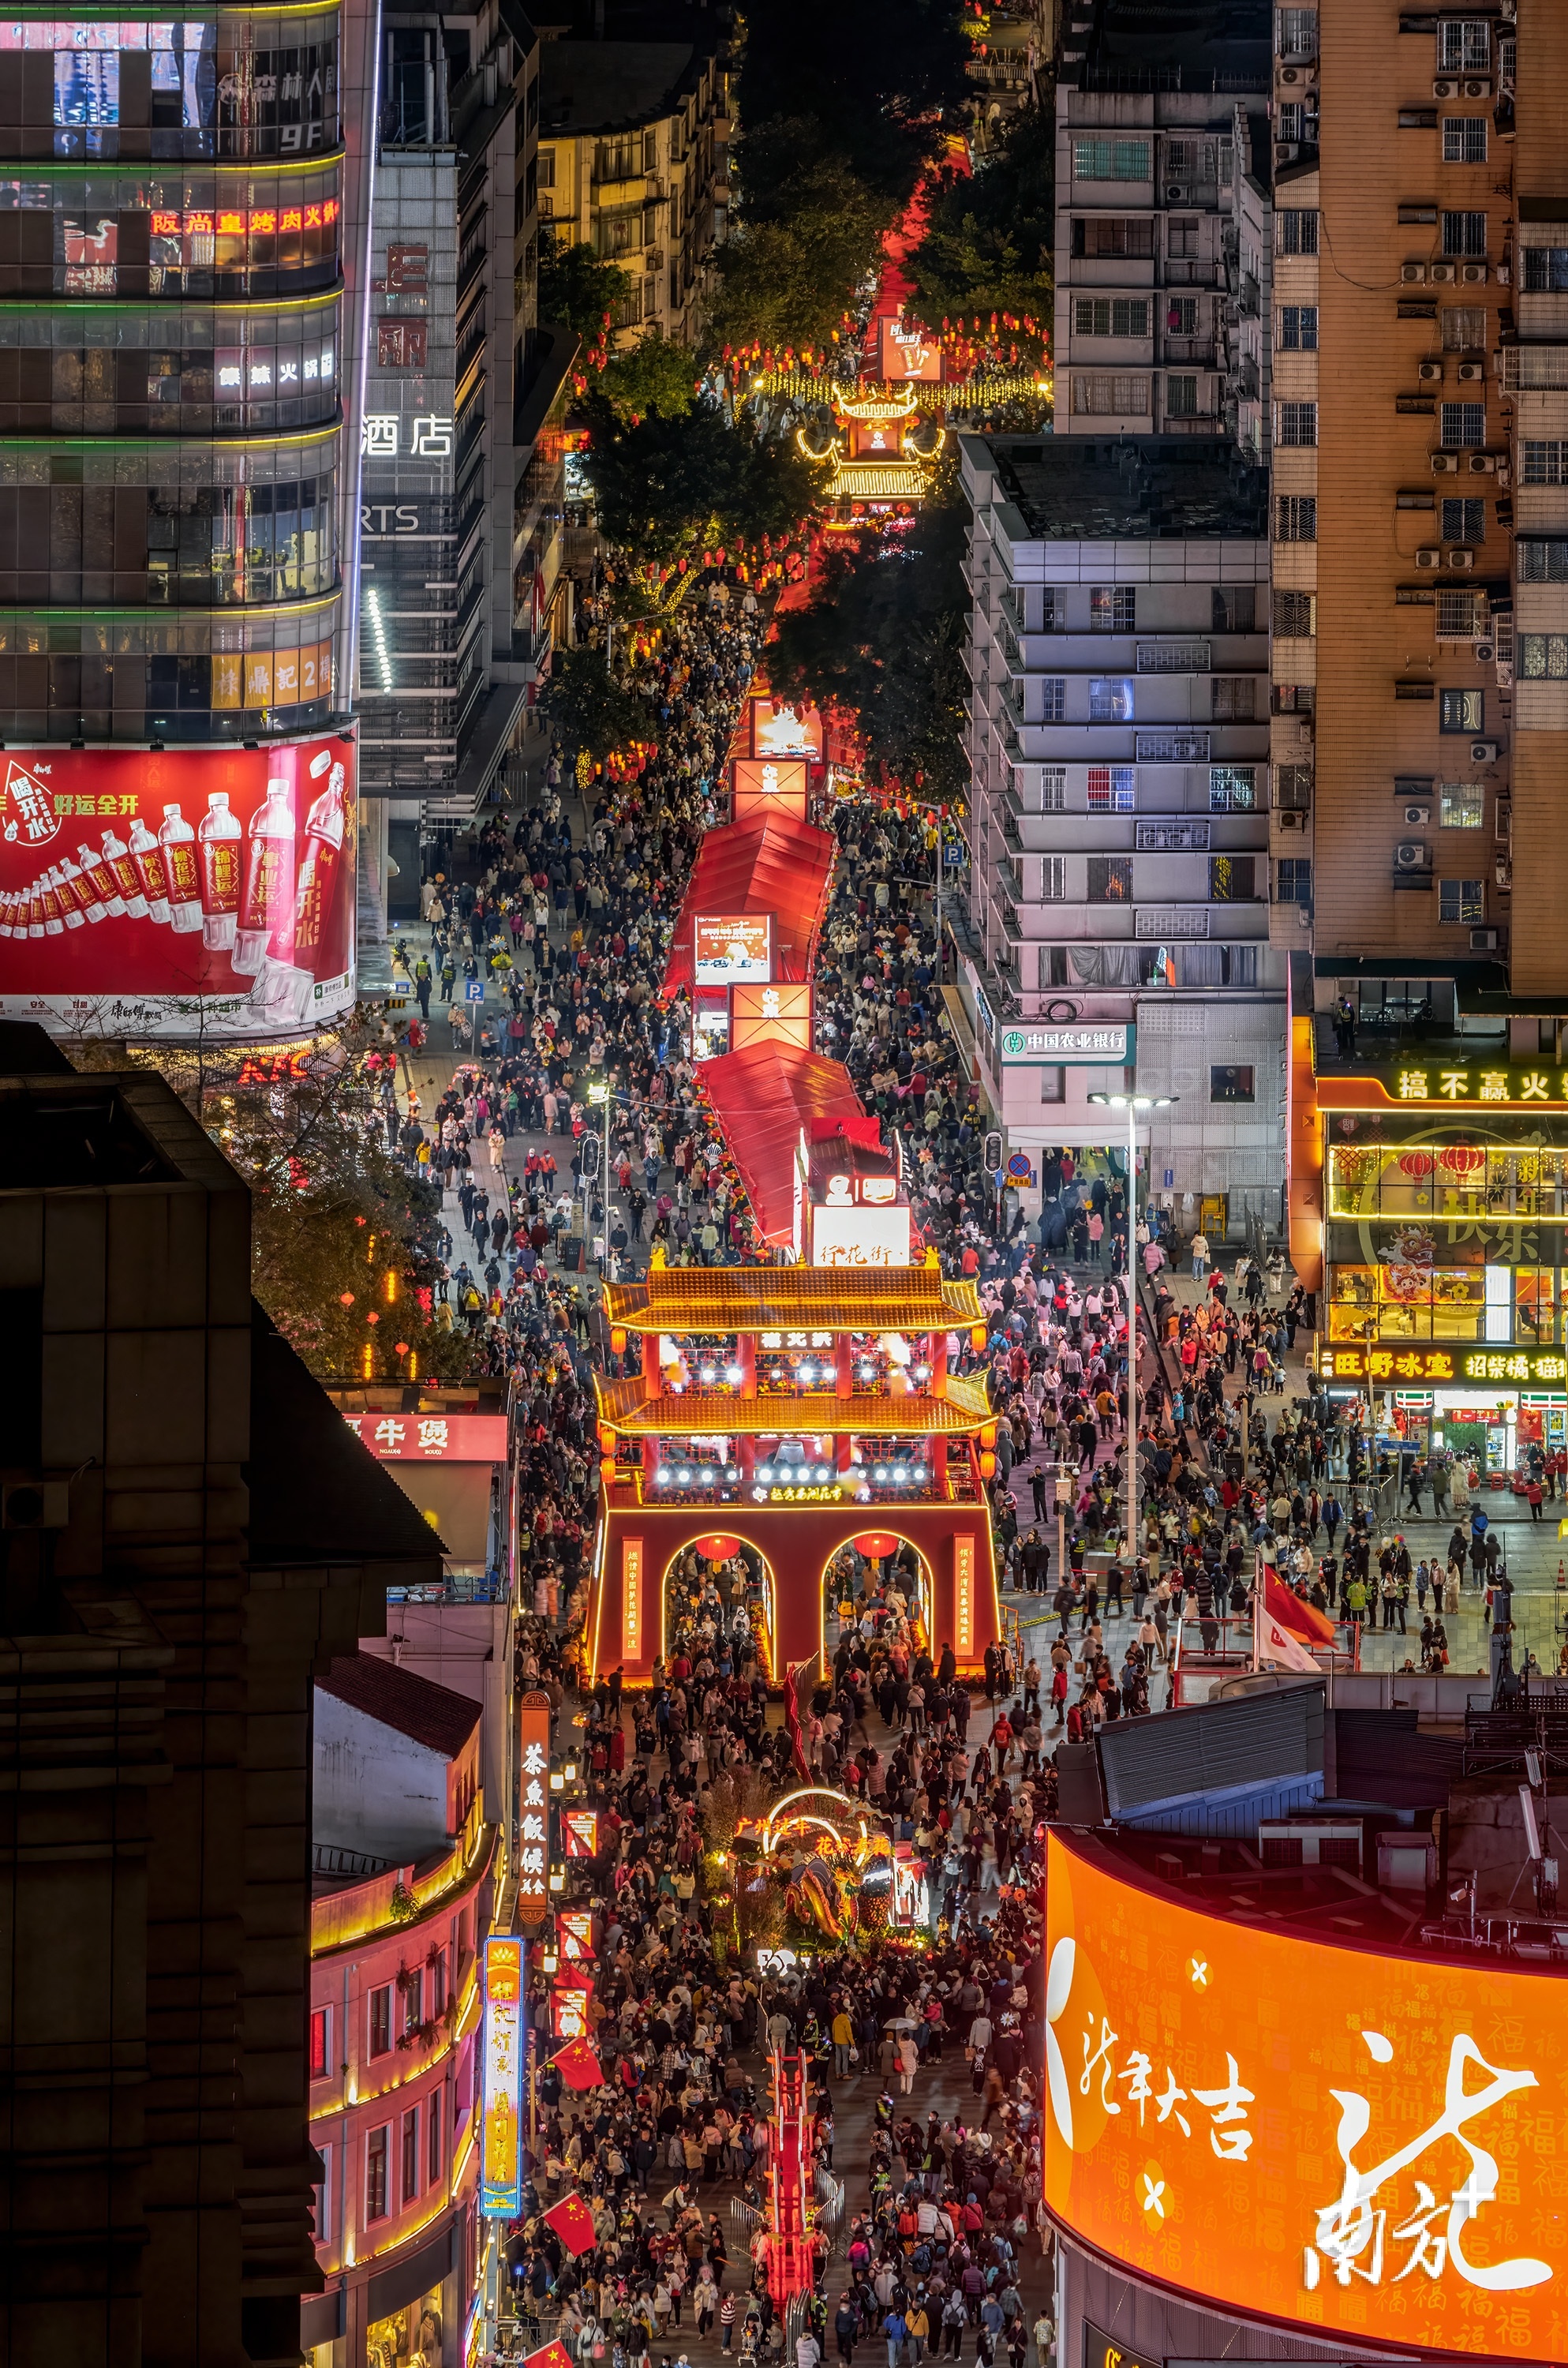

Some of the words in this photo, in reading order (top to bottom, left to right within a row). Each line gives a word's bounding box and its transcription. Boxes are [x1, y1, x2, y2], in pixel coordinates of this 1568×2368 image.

[280, 120, 323, 152] 9F
[360, 414, 452, 455] 酒店
[9, 776, 49, 841] 喝开水
[54, 795, 139, 815] 好运全开
[173, 850, 191, 886] 桃花运
[948, 848, 959, 861] P
[215, 850, 232, 893] 锦鲤运
[257, 852, 280, 903] 事业运
[295, 860, 315, 949] 喝开水
[470, 984, 481, 999] P
[1027, 1032, 1125, 1049] 中国农业银行
[238, 1050, 311, 1084] KFC
[1399, 1070, 1568, 1101] 搞不赢火
[735, 1817, 810, 1838] 广州过年
